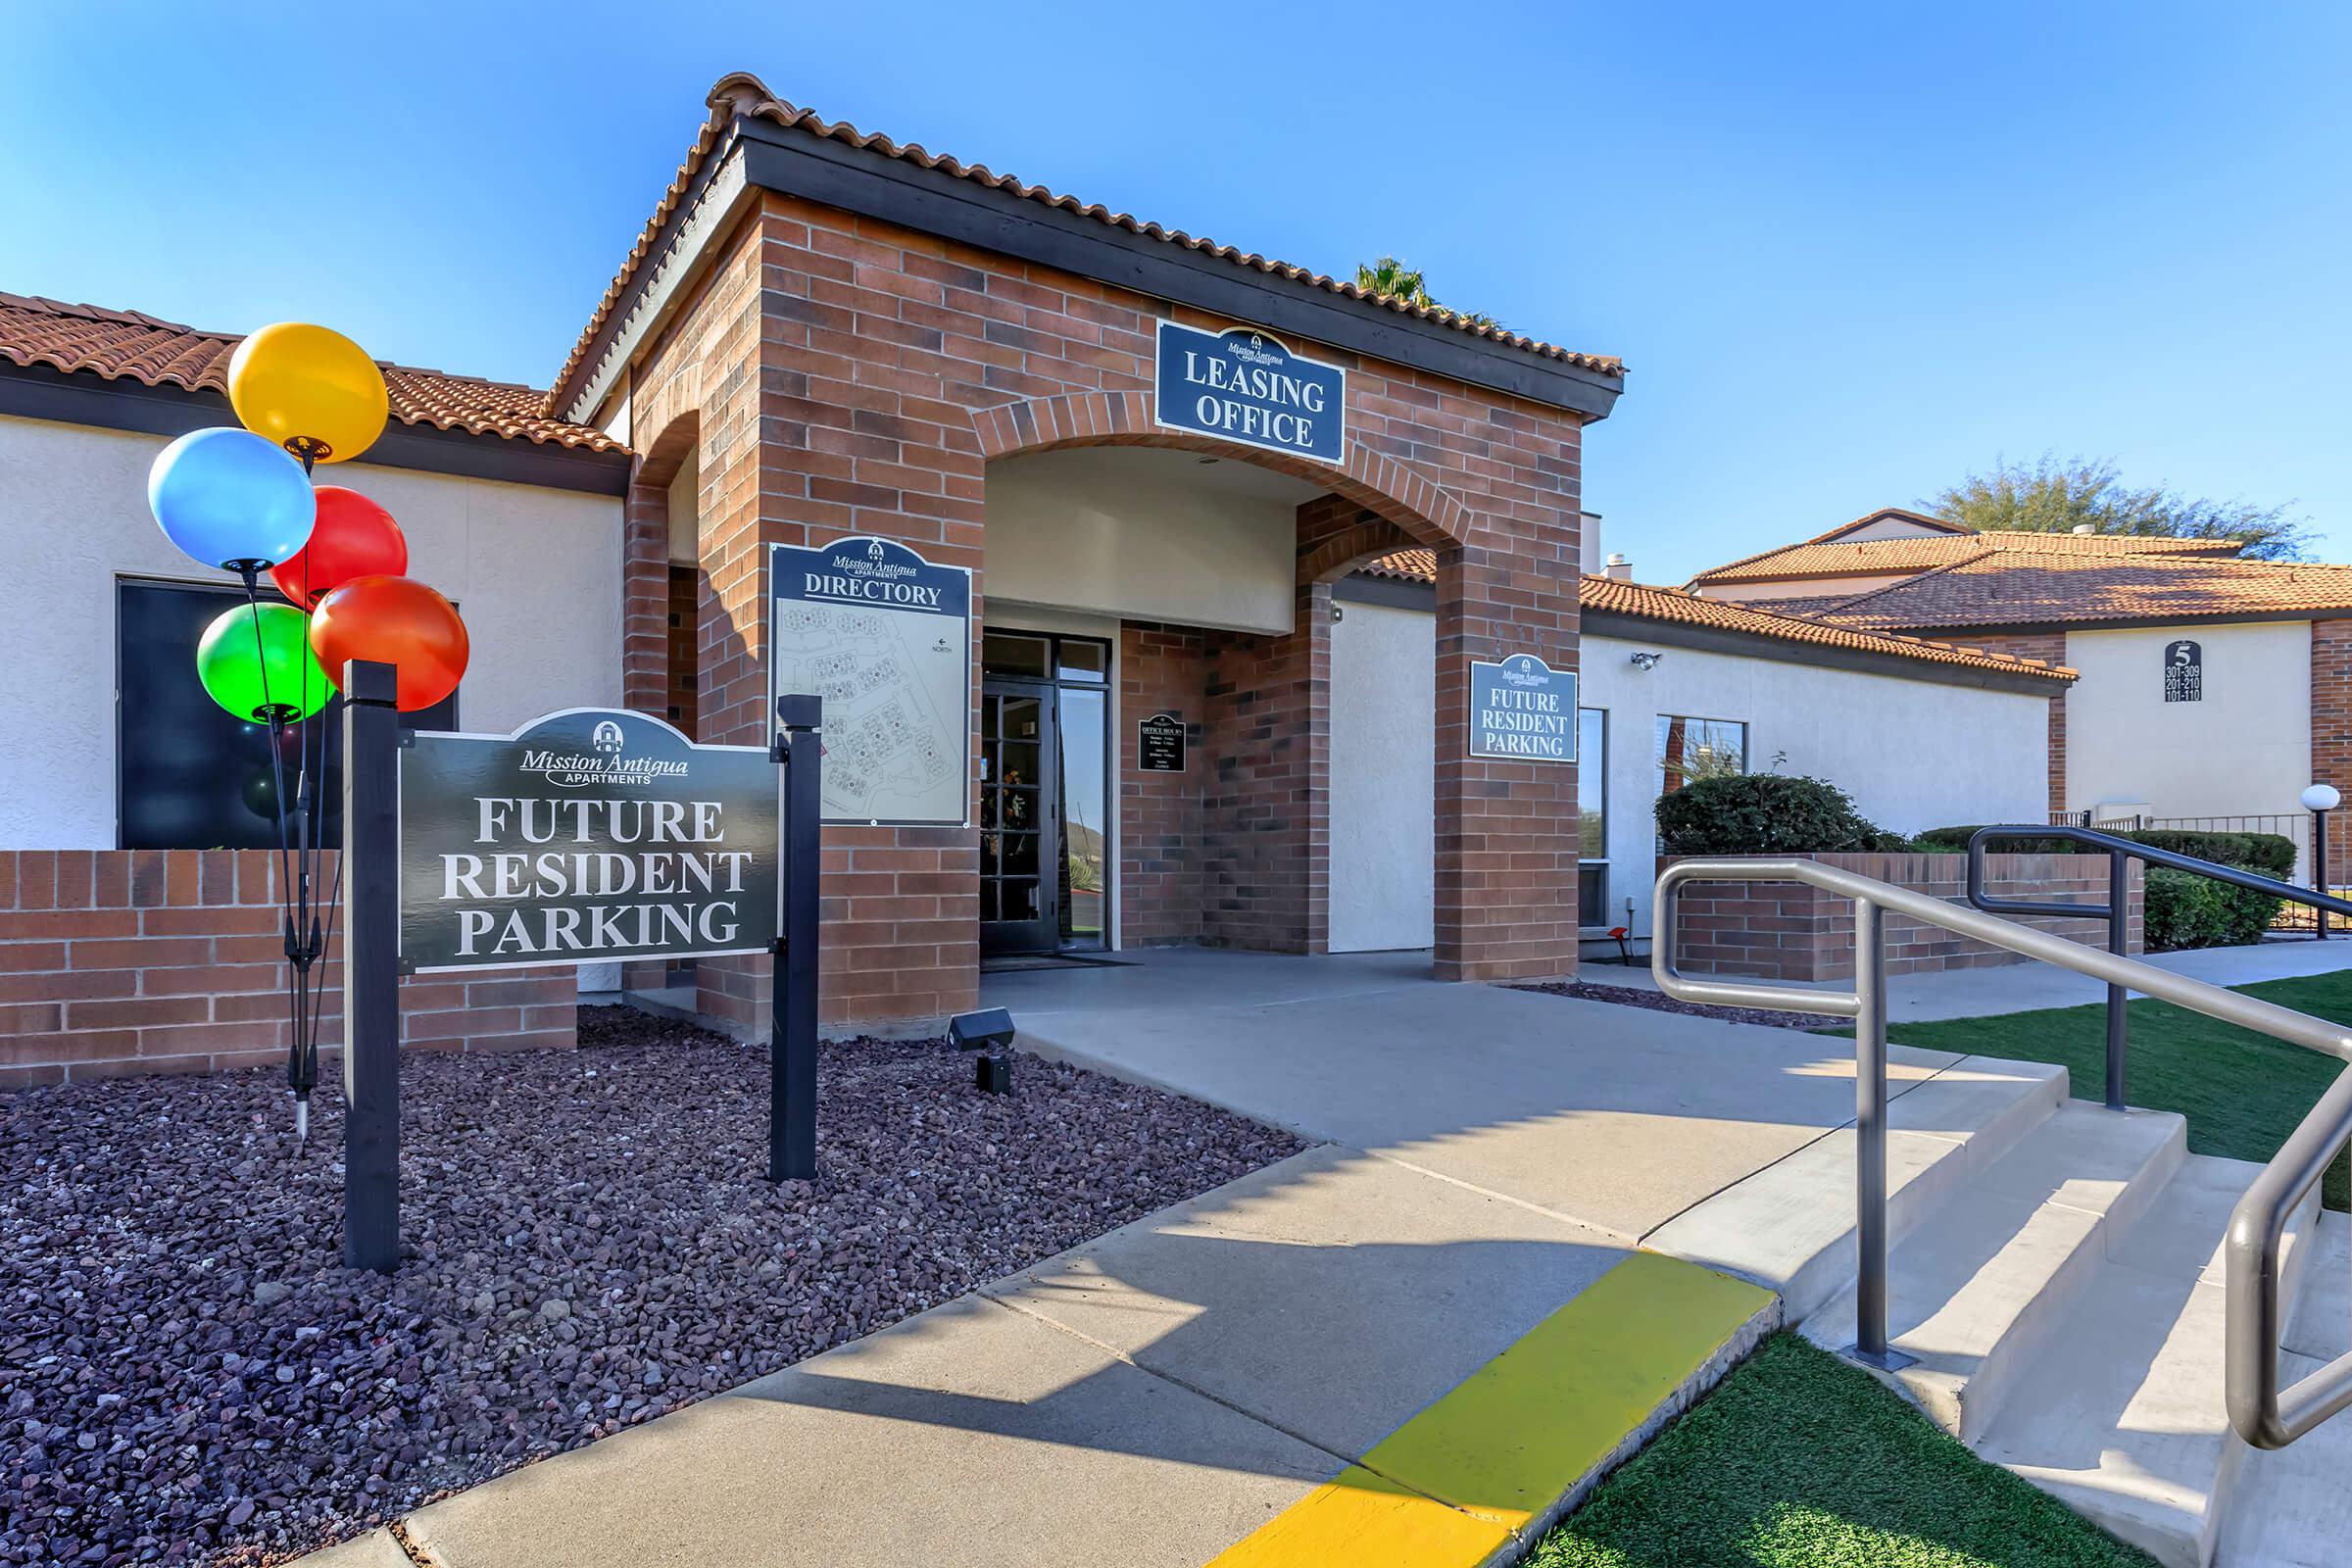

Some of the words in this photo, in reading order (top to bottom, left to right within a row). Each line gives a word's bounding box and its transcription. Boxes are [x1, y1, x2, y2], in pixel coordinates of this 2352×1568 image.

[1184, 351, 1325, 413] LEASING
[1196, 395, 1314, 448] OFFICE
[832, 555, 873, 569] Mission
[872, 561, 917, 576] Antigua
[855, 569, 898, 579] APARTMENTS
[805, 572, 942, 606] DIRECTORY
[2175, 645, 2191, 667] 5
[2166, 665, 2200, 678] 301-309
[2166, 677, 2200, 690] 201-210
[1491, 688, 1559, 712] FUTURE
[2167, 689, 2200, 702] 101-110
[1482, 710, 1568, 735] RESIDENT
[1485, 732, 1563, 757] PARKING
[519, 750, 603, 771] Mission
[603, 754, 689, 777] Antigua
[564, 772, 652, 785] APARTMENTS
[473, 798, 725, 844] FUTURE
[438, 852, 753, 901] RESIDENT
[454, 901, 740, 956] PARKING
